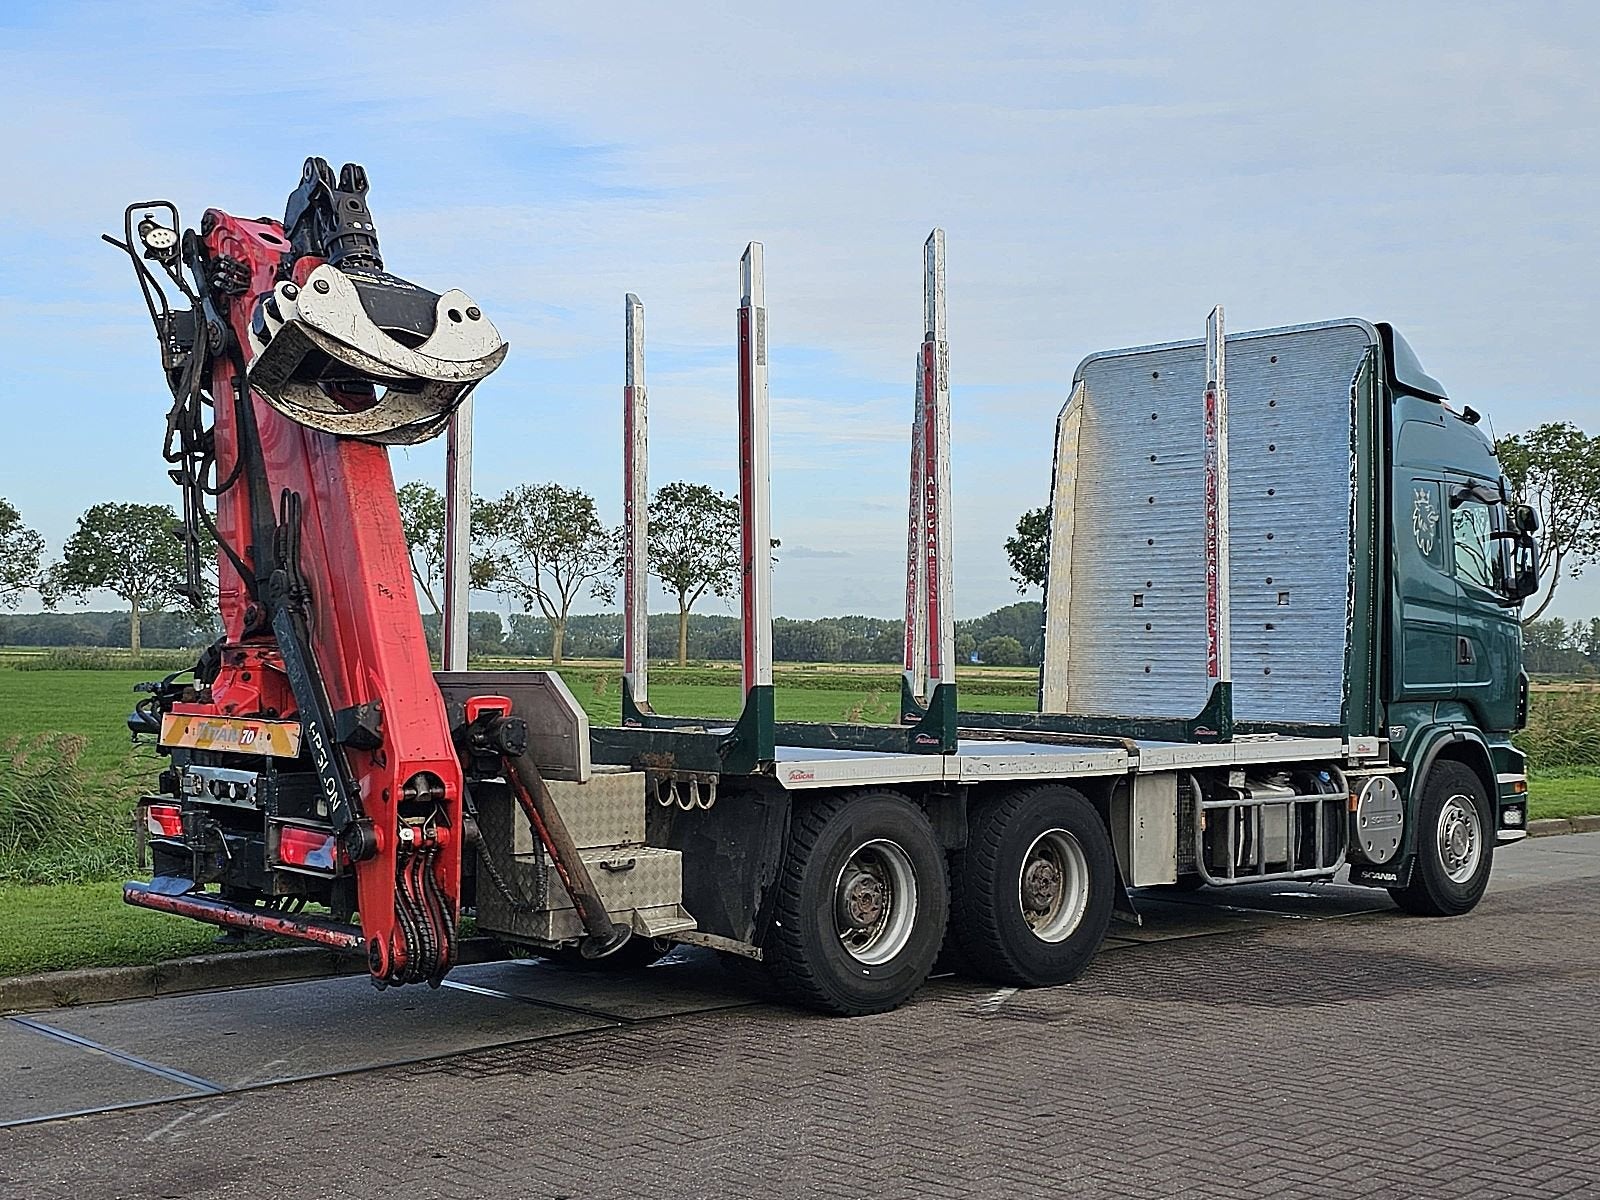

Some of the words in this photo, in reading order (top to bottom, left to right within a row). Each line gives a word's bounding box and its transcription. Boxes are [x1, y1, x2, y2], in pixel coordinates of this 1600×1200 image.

[927, 475, 936, 557] ALUCAR
[240, 729, 255, 745] 70
[1361, 871, 1397, 881] SCANIA
